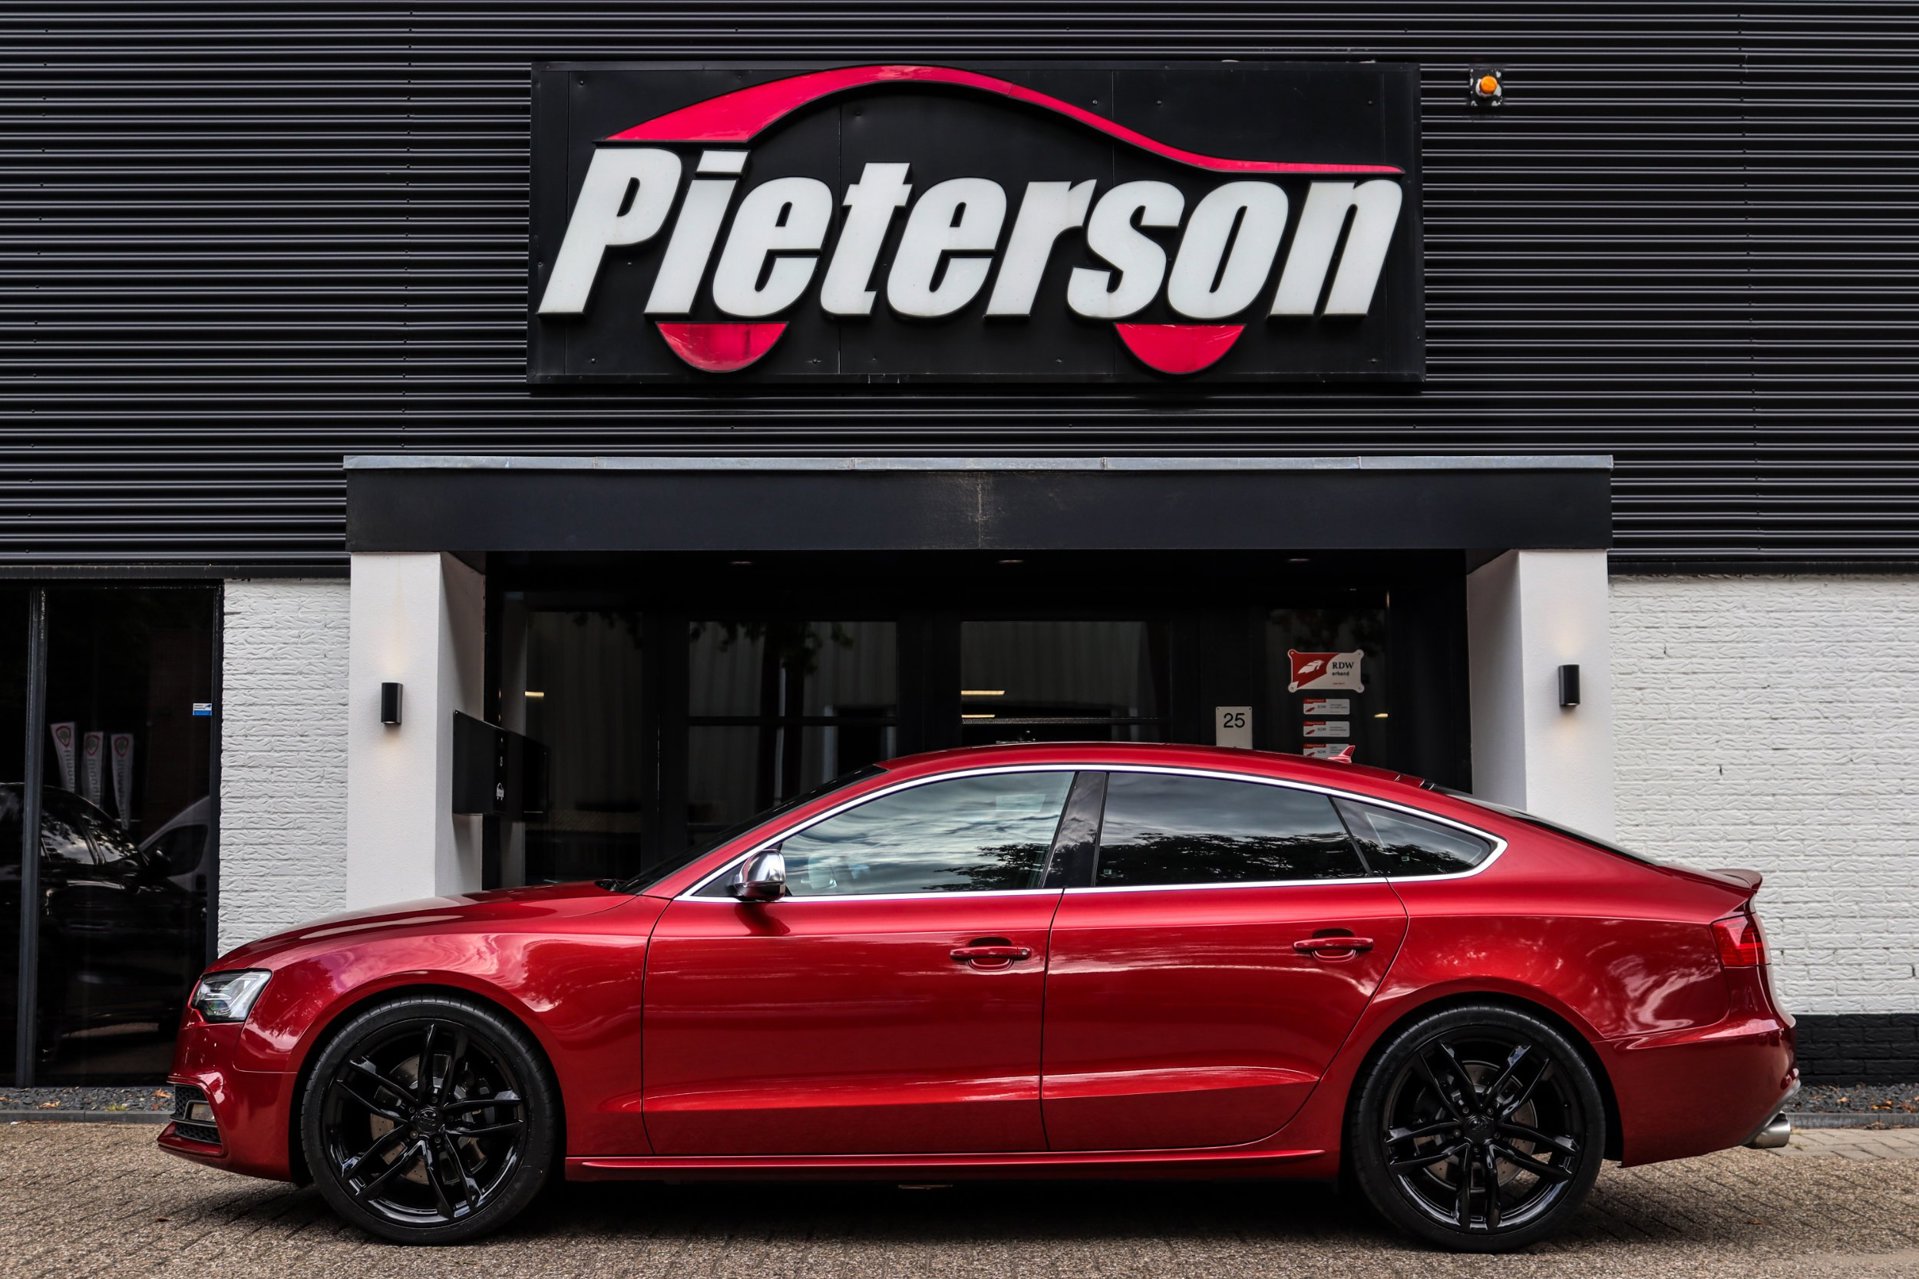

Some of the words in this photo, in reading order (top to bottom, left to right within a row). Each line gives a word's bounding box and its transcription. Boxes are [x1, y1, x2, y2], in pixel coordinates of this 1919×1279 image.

[537, 148, 1403, 319] Pieterson
[1332, 661, 1354, 669] RDW
[1223, 713, 1245, 728] 25
